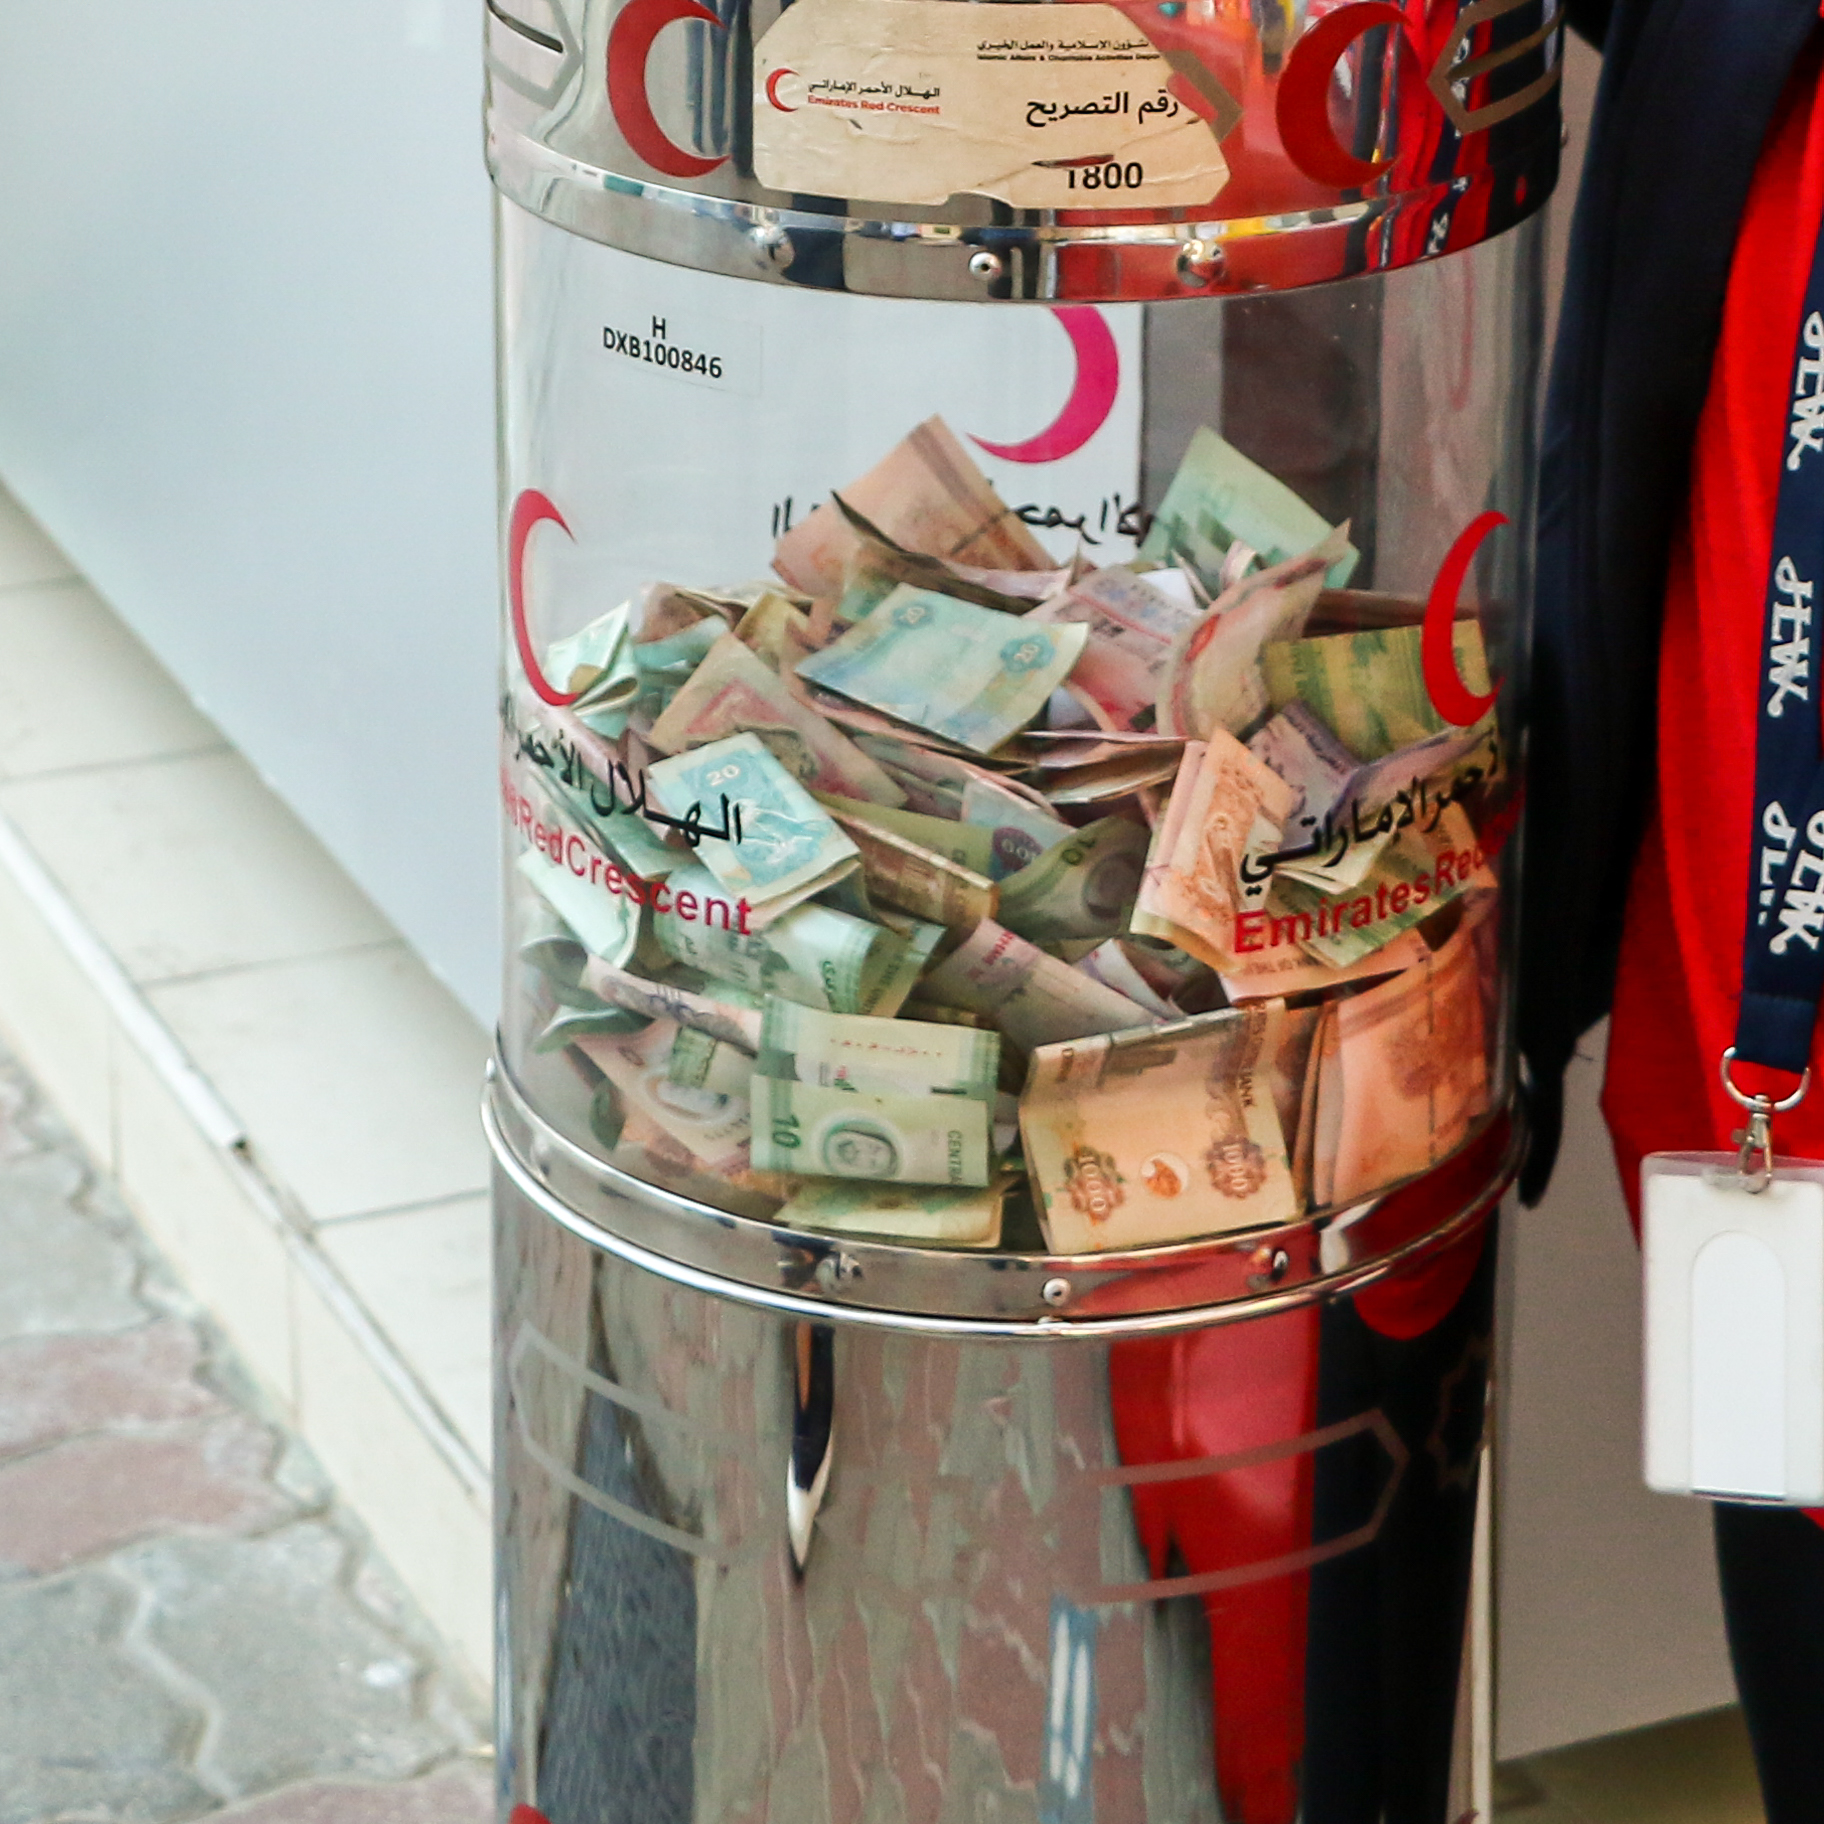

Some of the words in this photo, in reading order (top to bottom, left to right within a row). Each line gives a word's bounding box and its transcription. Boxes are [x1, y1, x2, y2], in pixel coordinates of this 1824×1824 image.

[808, 93, 859, 109] Emirates
[860, 98, 884, 111] Red
[886, 102, 941, 115] Crescent
[1025, 90, 1129, 127] التصريح
[1137, 90, 1179, 124] رقم
[1066, 161, 1143, 190] 1800
[652, 315, 666, 340] H
[603, 326, 723, 379] DXB100846
[705, 762, 742, 787] 20
[771, 1114, 801, 1150] 10
[1079, 1153, 1108, 1214] 1000
[1221, 1142, 1249, 1195] 1000
